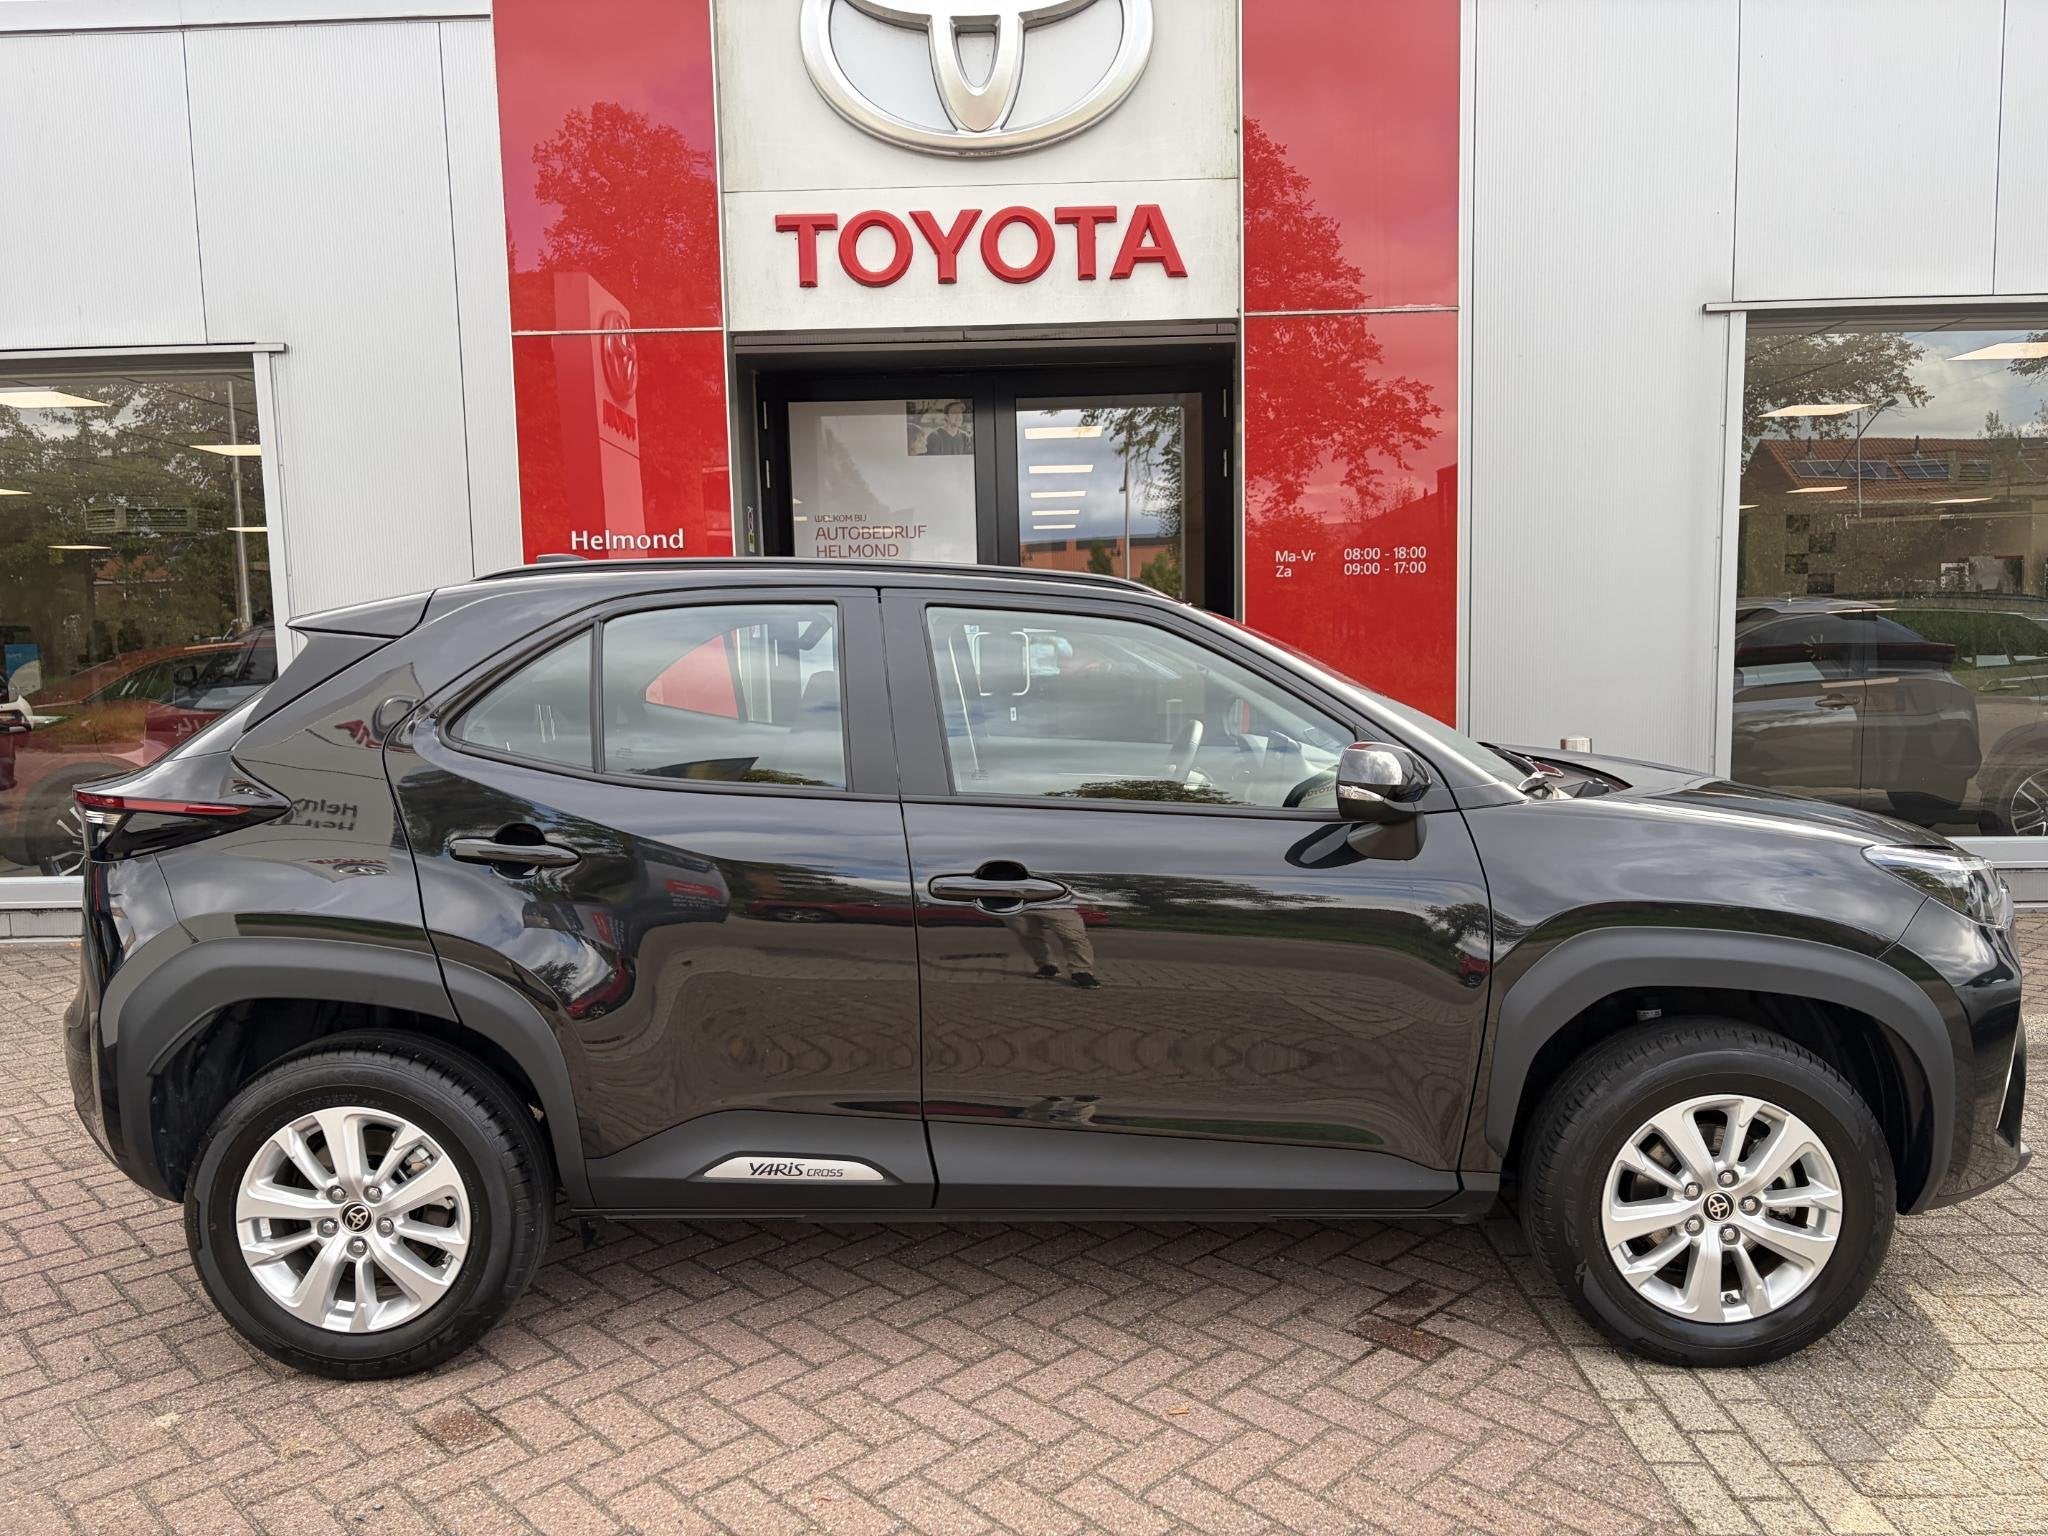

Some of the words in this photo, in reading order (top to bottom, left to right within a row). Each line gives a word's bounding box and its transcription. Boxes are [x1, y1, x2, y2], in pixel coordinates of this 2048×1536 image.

[775, 203, 1188, 288] TOYOTA
[854, 514, 867, 522] BIJ
[571, 528, 684, 551] Helmond
[815, 525, 928, 541] AUTOBEDRIJF
[816, 543, 899, 559] HELMOND
[1275, 549, 1316, 563] Ma-Vr
[1343, 547, 1381, 561] 08:00
[1393, 546, 1427, 560] 18:00
[1275, 565, 1292, 578] Za
[1343, 562, 1381, 576] 09:00
[1393, 561, 1427, 574] 17:00
[806, 1168, 844, 1178] CROSS
